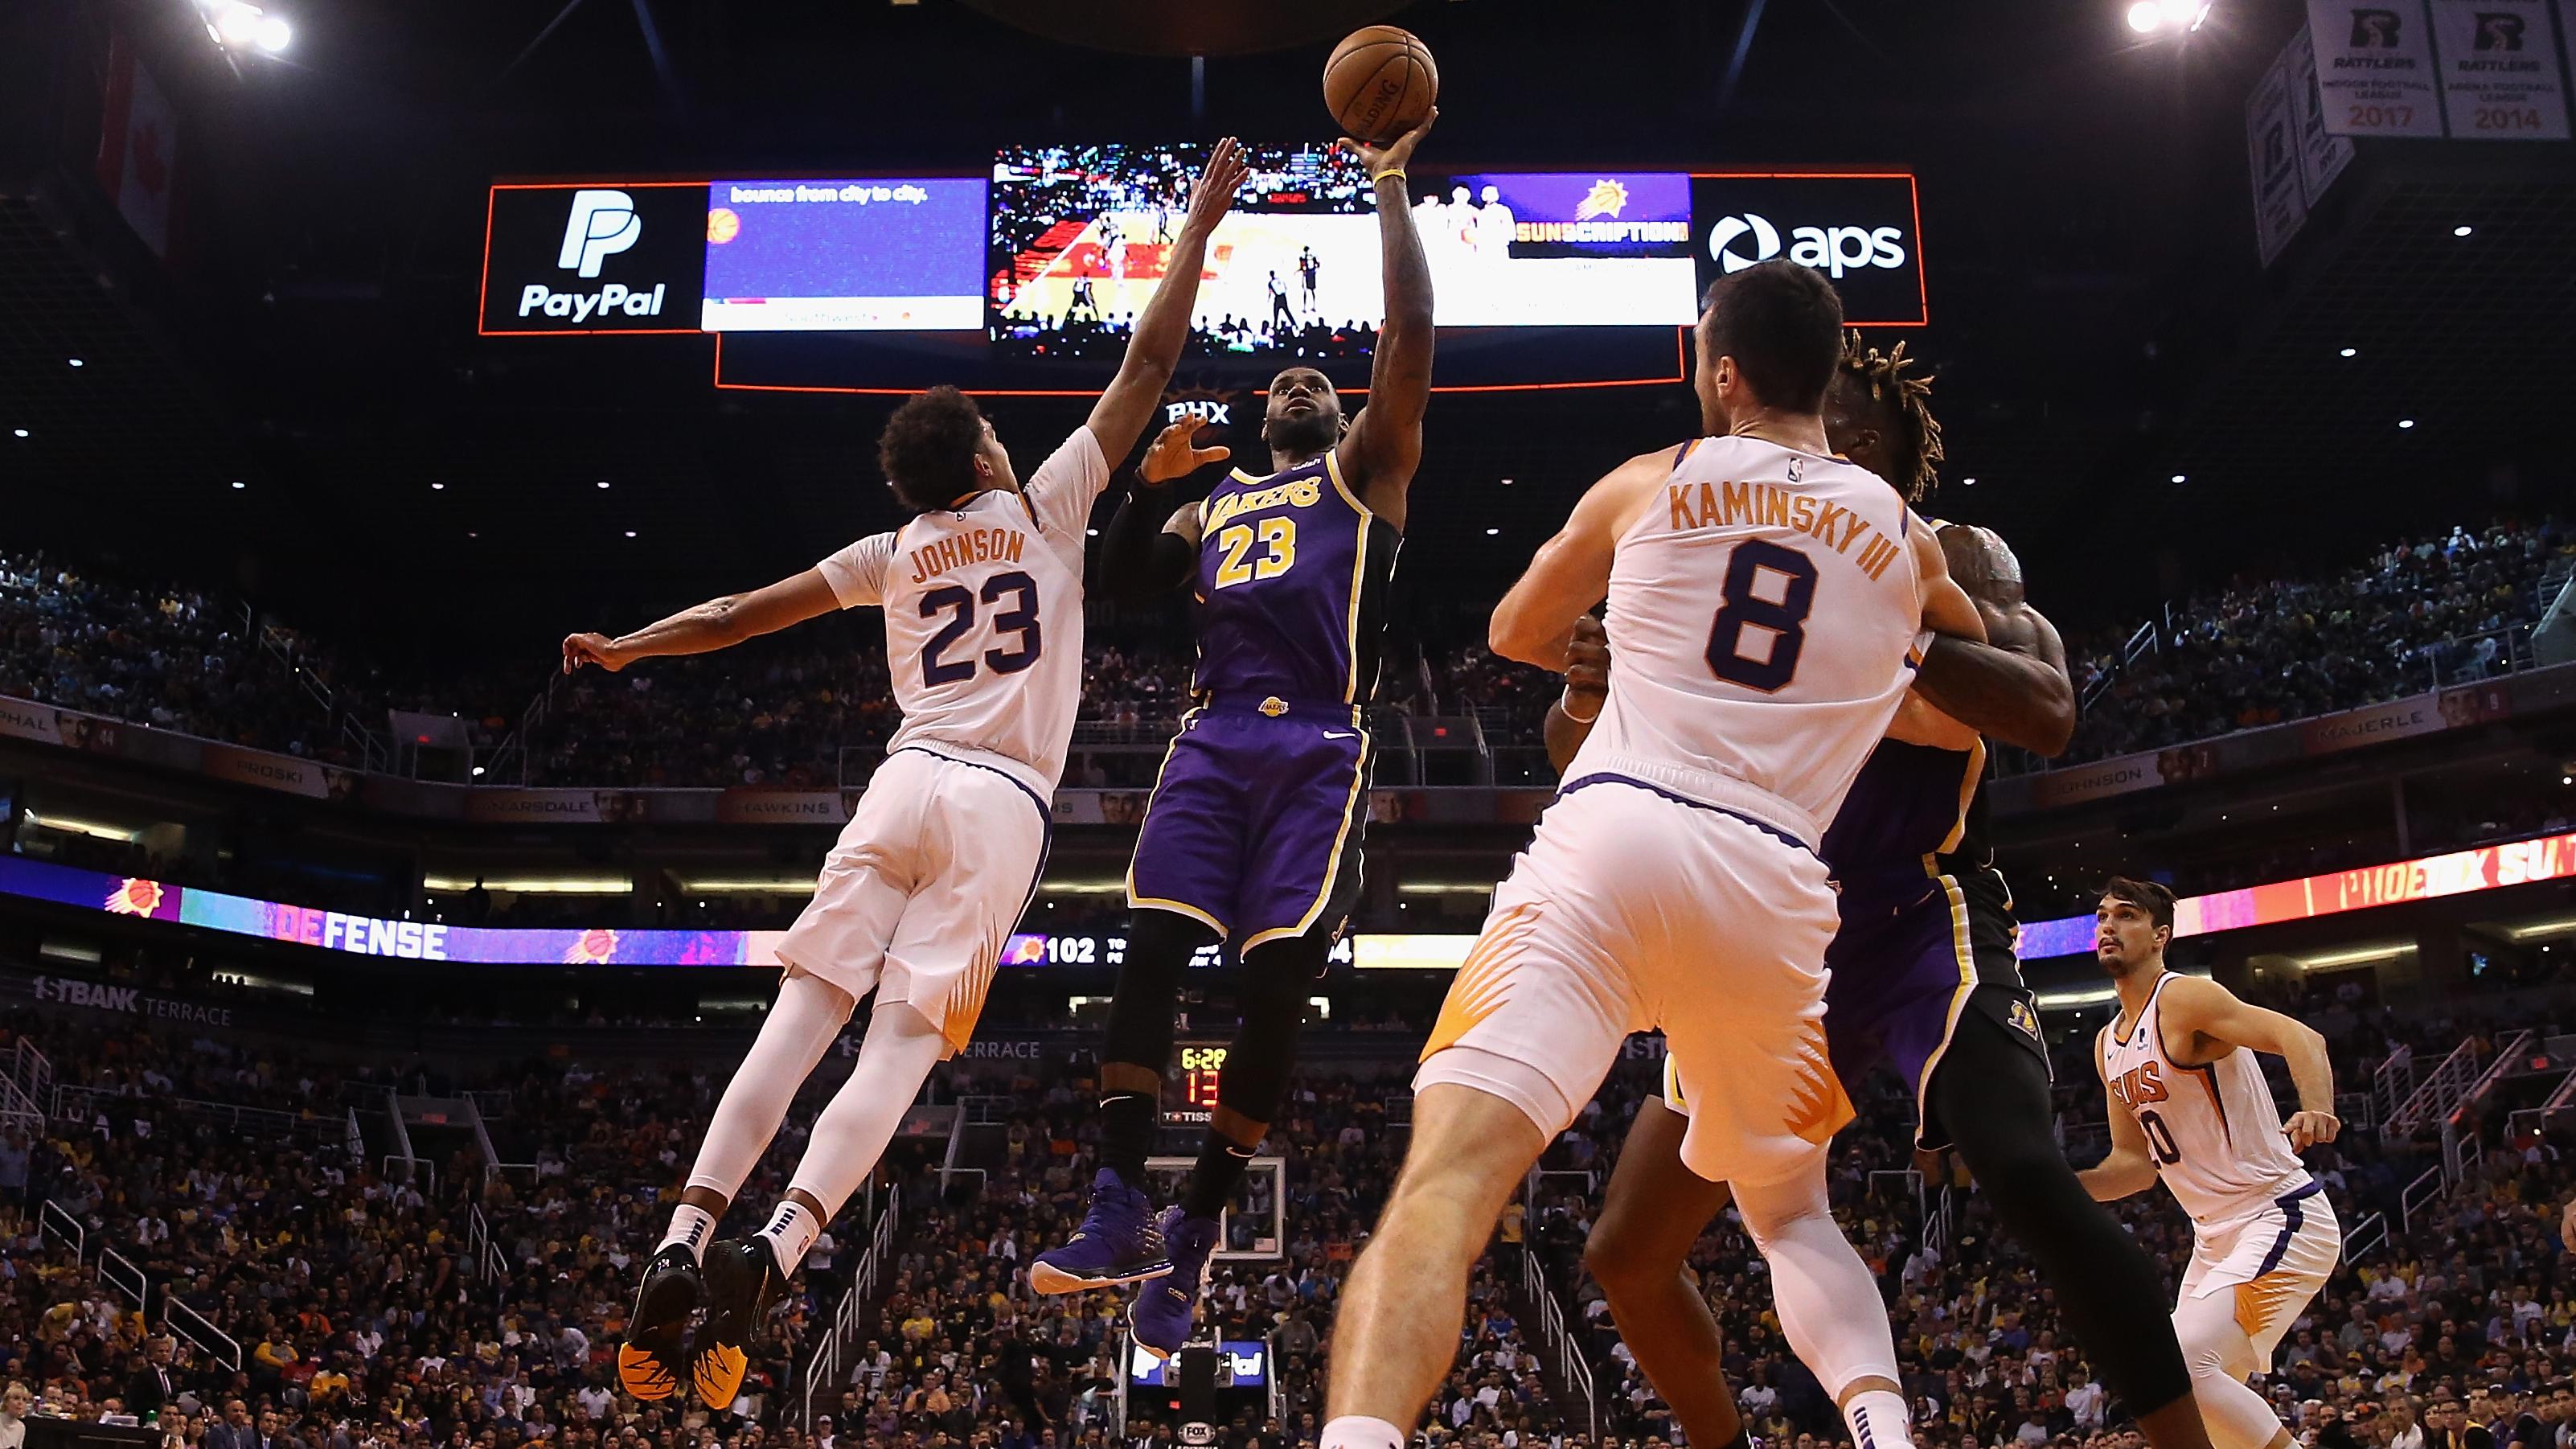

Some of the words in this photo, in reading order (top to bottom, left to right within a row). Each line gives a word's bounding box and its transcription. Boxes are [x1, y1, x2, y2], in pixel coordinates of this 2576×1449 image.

[2334, 58, 2416, 69] RATTLERS
[2458, 60, 2541, 72] RATTLERS
[2348, 104, 2413, 127] 2017
[2476, 109, 2542, 130] 2014
[730, 186, 795, 203] bounce
[796, 184, 838, 203] from
[839, 184, 872, 205] city
[872, 186, 892, 203] to
[892, 184, 928, 205] city.
[1790, 225, 1905, 278] aps
[519, 283, 666, 322] PayPal
[1166, 401, 1231, 425] PHX
[1201, 476, 1322, 542] LAKERS
[1669, 482, 1870, 554] KAMINSKY
[1856, 532, 1900, 581] III
[910, 528, 1025, 584] JOHNSON
[1215, 516, 1297, 590] 23
[919, 570, 1043, 689] 23
[1704, 538, 1819, 695] 8
[2317, 711, 2424, 742] MAJERLE
[2057, 767, 2142, 795] JOHNSON
[508, 802, 589, 813] ARSDALE
[276, 903, 448, 961] DEFENSE
[1046, 937, 1095, 963] 102
[33, 975, 140, 1013] 1STBANK
[144, 997, 232, 1027] TERRACE
[963, 1041, 1040, 1059] ERRACE
[1182, 1048, 1228, 1069] 6:28
[1189, 1070, 1219, 1106] 13
[2141, 1110, 2181, 1169] 0
[1187, 1426, 1207, 1436] FOX
